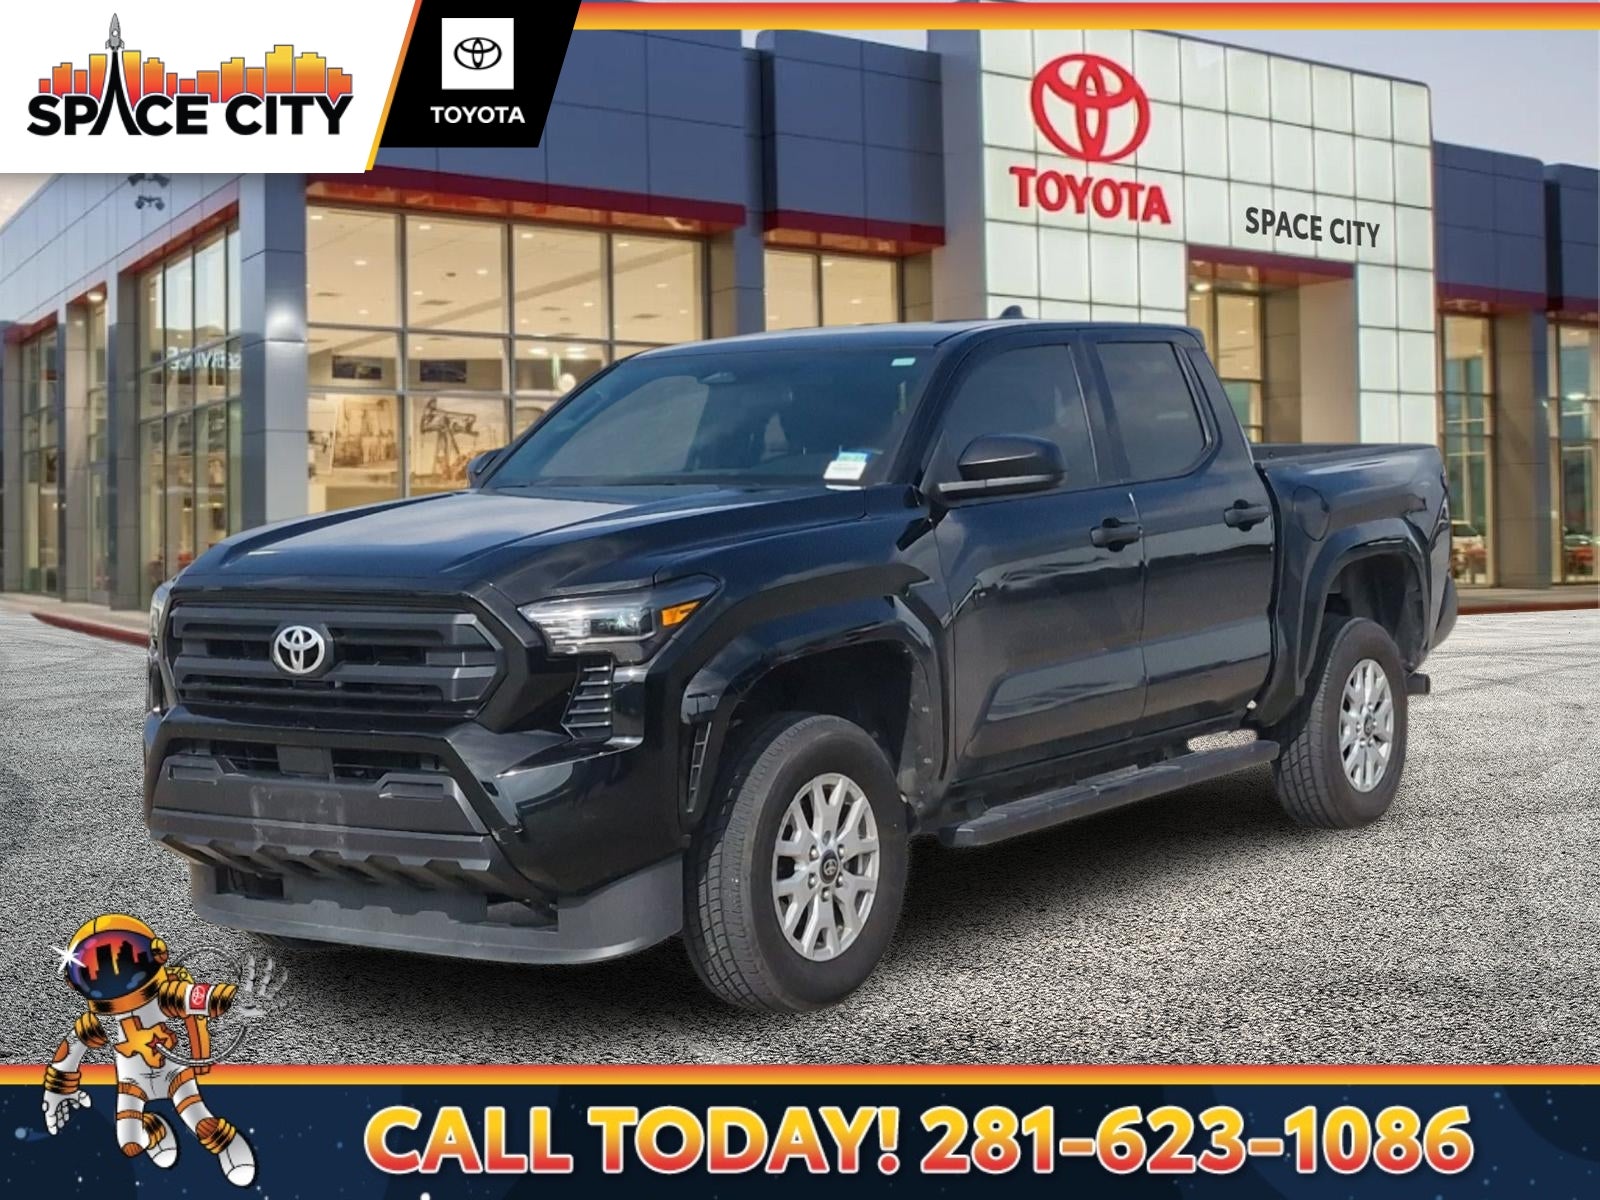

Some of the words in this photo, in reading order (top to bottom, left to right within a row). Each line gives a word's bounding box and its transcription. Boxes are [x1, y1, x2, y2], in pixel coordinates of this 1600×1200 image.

[1009, 166, 1171, 225] TOYOTA
[1245, 206, 1322, 242] SPACE
[1329, 217, 1380, 248] CITY
